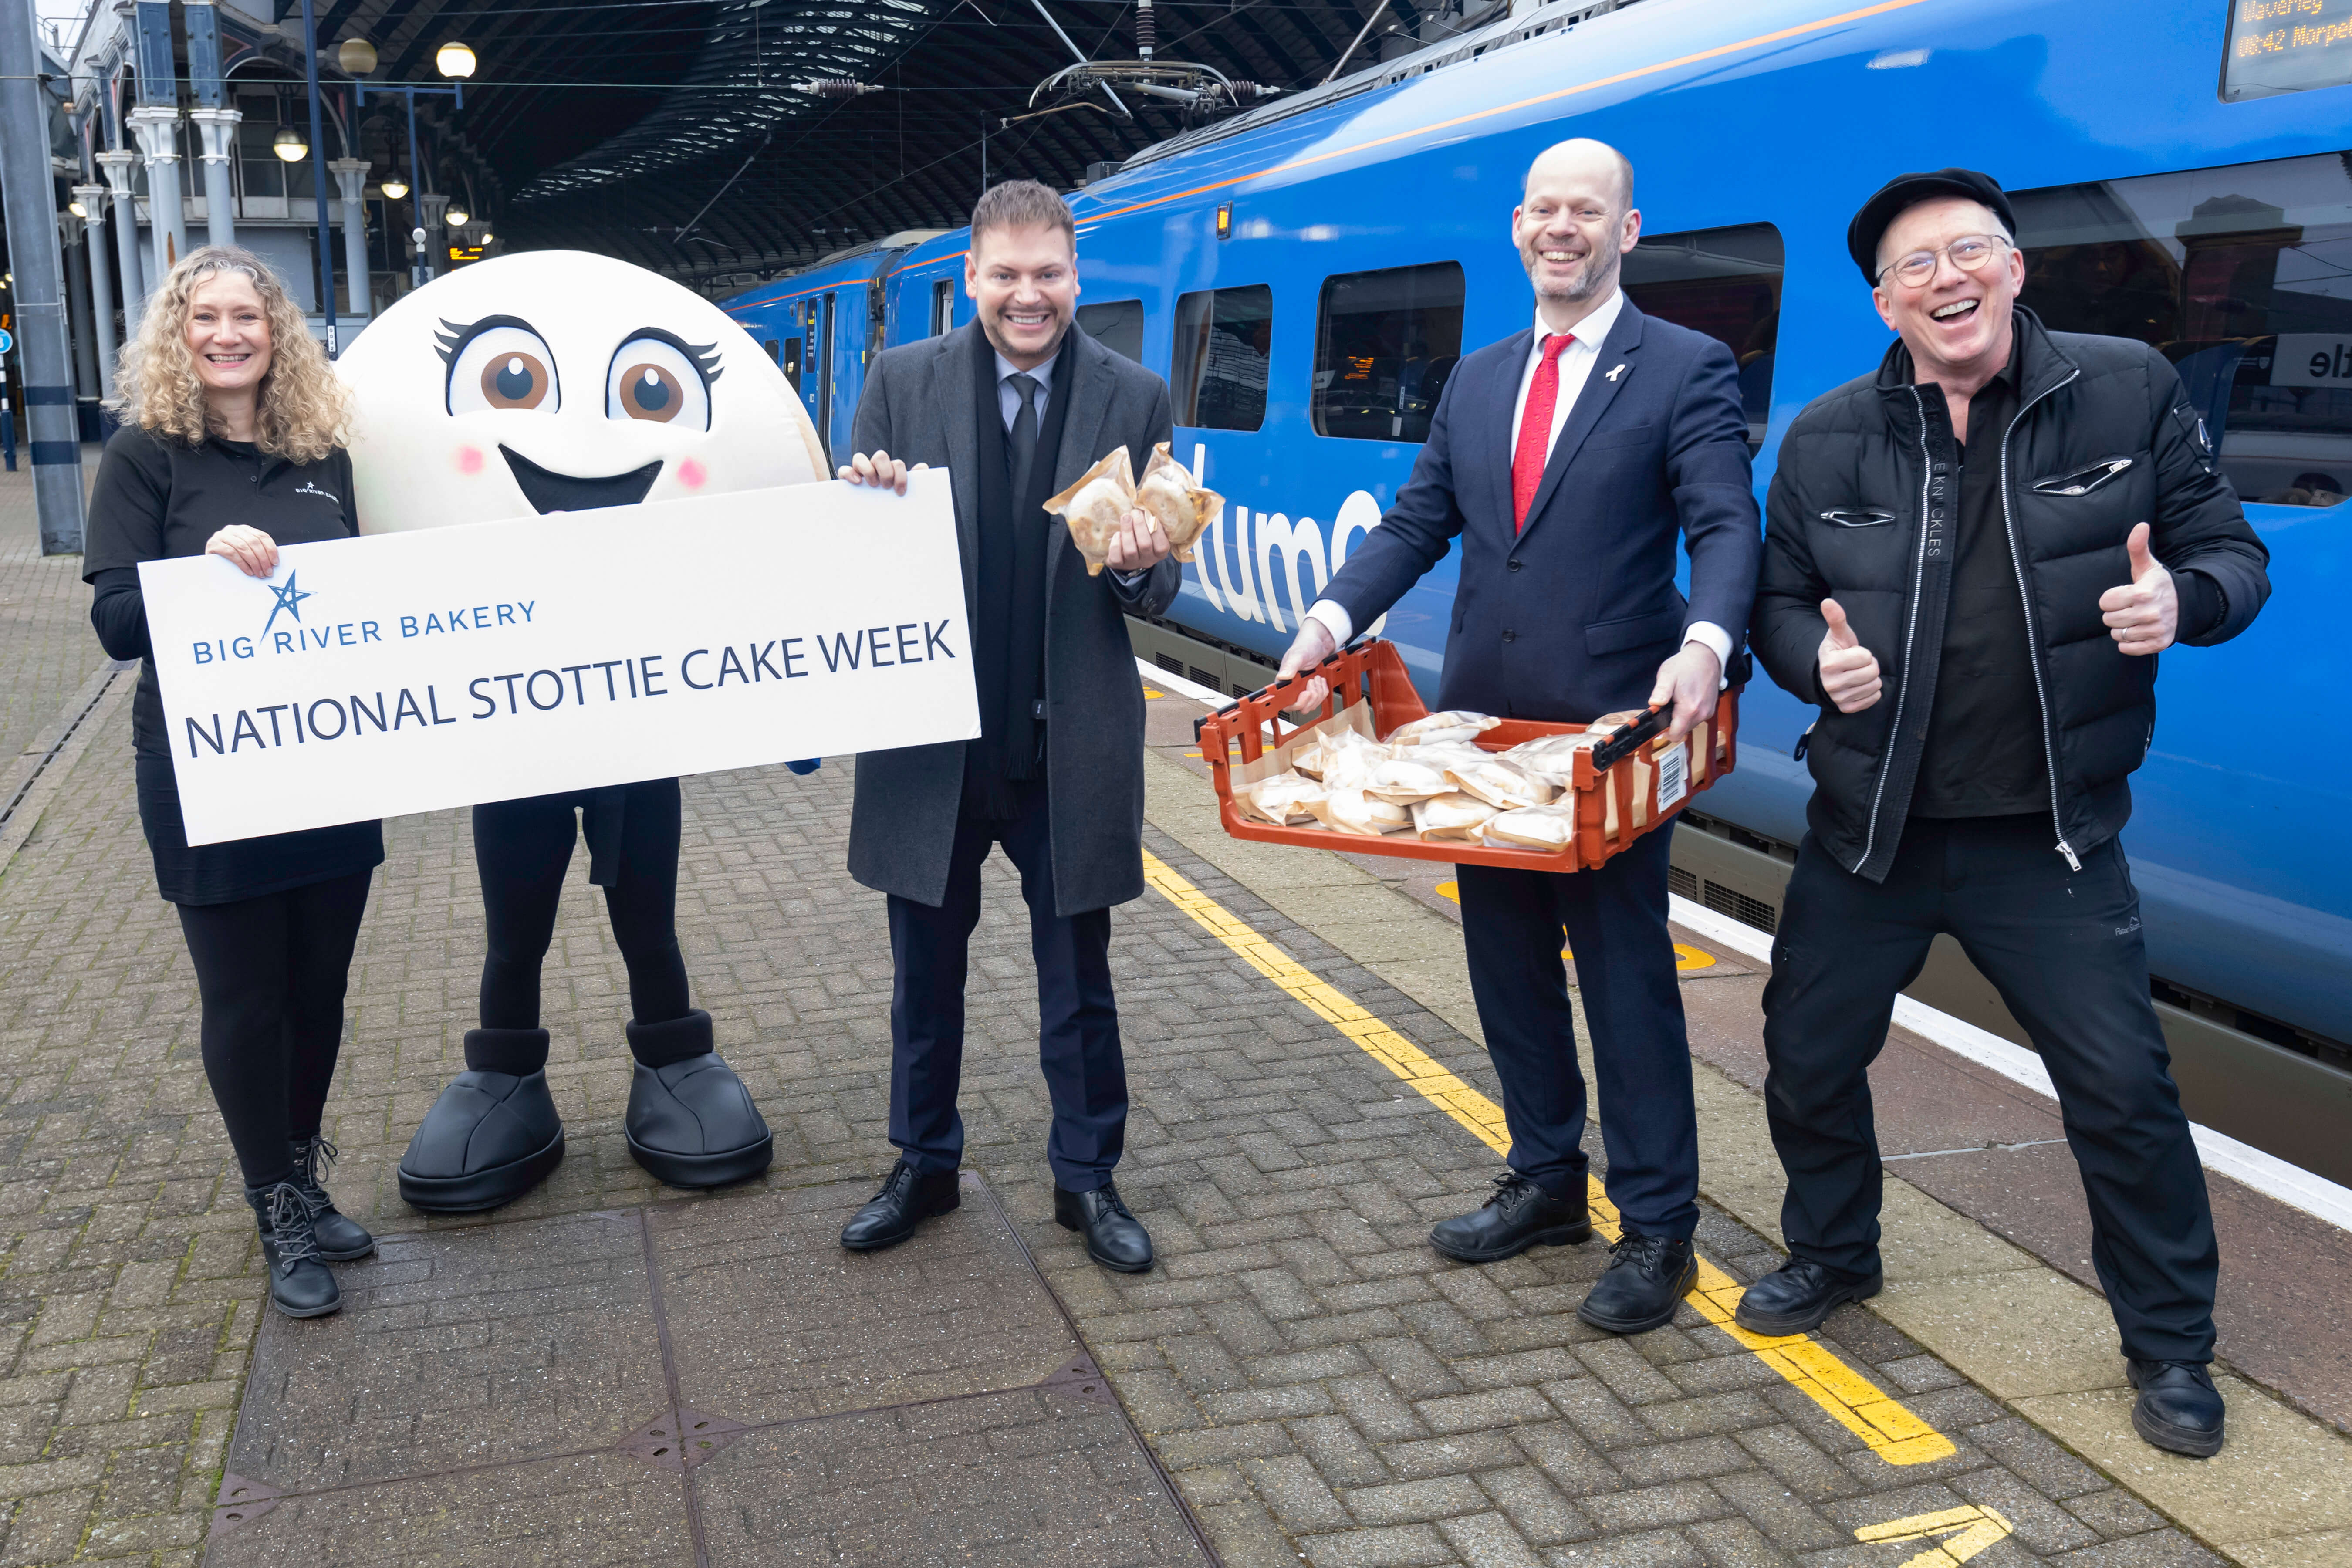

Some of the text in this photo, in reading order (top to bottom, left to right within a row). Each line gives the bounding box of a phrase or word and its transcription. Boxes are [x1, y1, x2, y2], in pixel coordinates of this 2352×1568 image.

[1927, 476, 1946, 557] KNUCKLES
[193, 601, 534, 664] BIG RIVER BAKERY
[186, 619, 955, 758] NATIONAL STOTTIE CAKE WEEK
